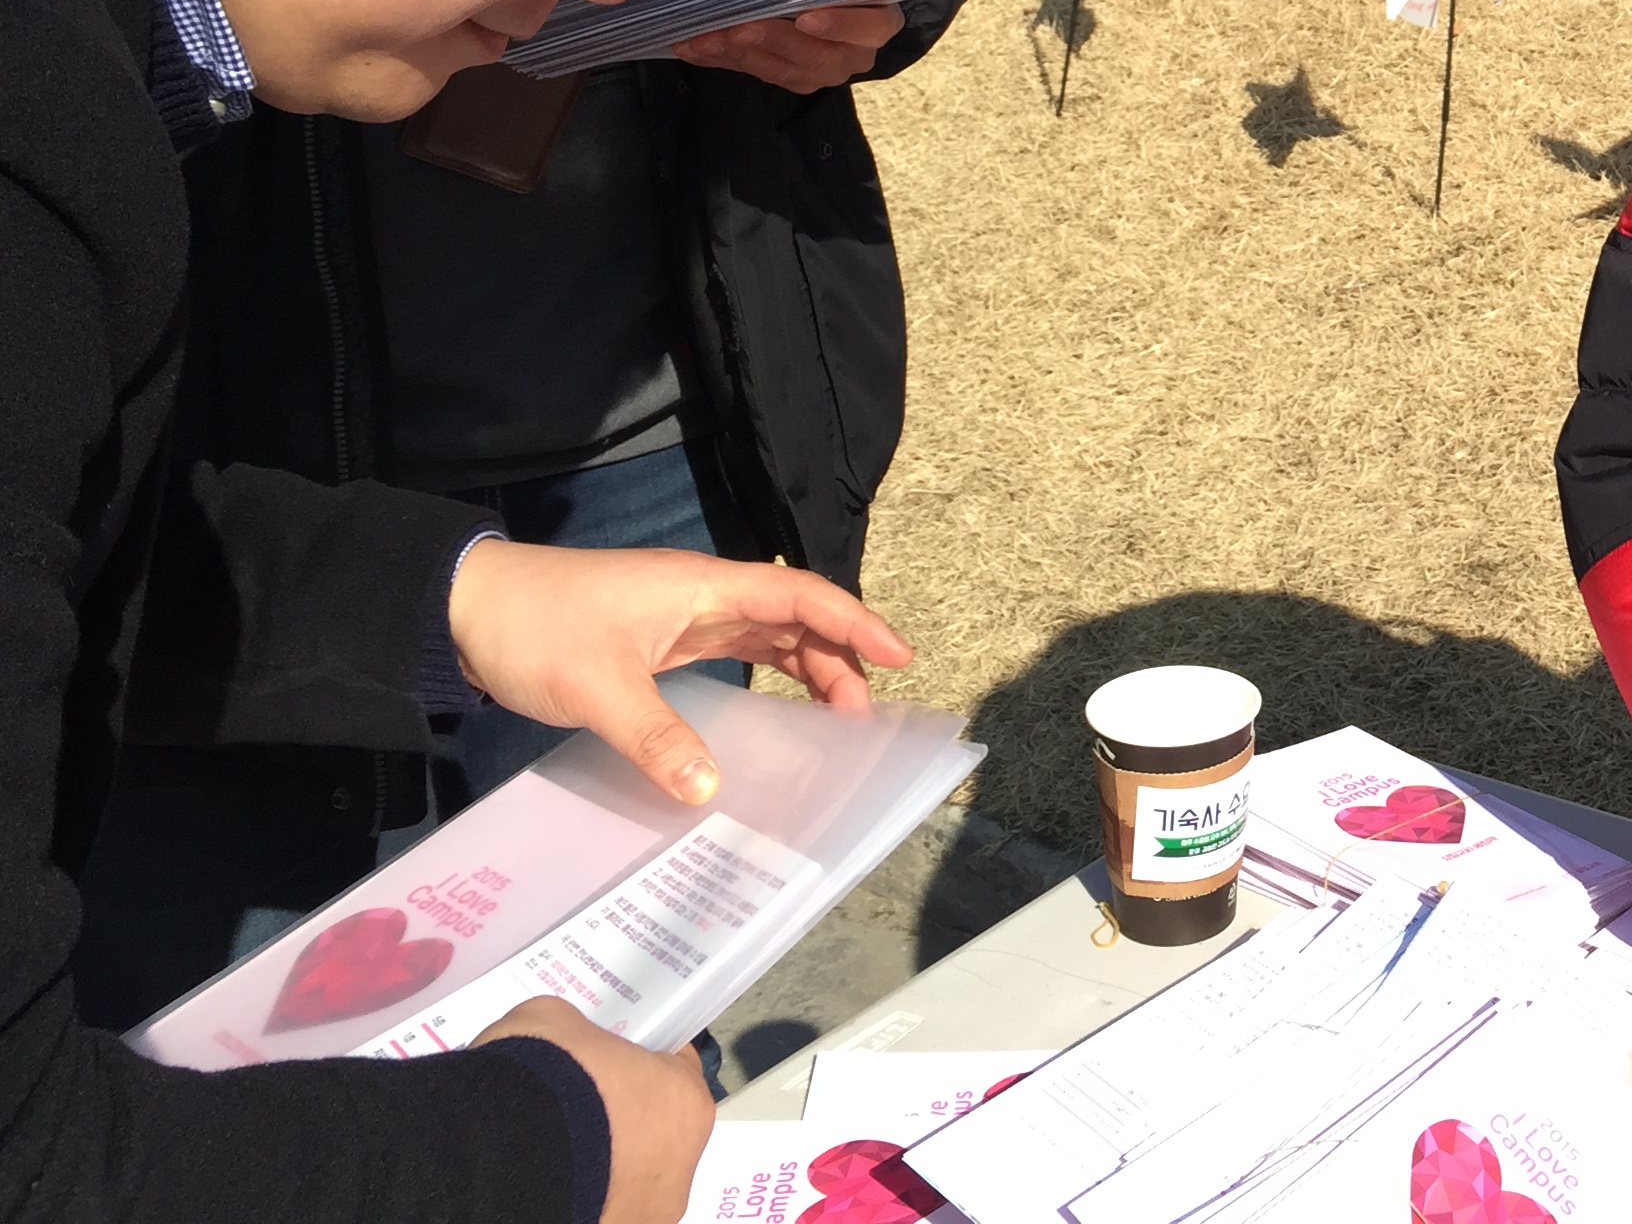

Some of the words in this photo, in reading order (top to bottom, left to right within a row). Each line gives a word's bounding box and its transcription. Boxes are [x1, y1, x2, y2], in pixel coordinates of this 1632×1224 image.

[1319, 773, 1353, 788] 2015
[1322, 777, 1400, 807] Campus
[1329, 775, 1379, 795] Love
[1154, 803, 1221, 832] 기숙사
[435, 872, 459, 889] I
[471, 866, 512, 891] 2015
[406, 885, 484, 938] Campus
[446, 879, 497, 916] Love
[1512, 1112, 1526, 1125] I
[1525, 1128, 1578, 1190] Love
[1540, 1118, 1580, 1161] 2015
[1490, 1114, 1576, 1215] Campus
[717, 1186, 739, 1220] 2015
[737, 1173, 771, 1219] Love
[766, 1161, 798, 1224] ampus
